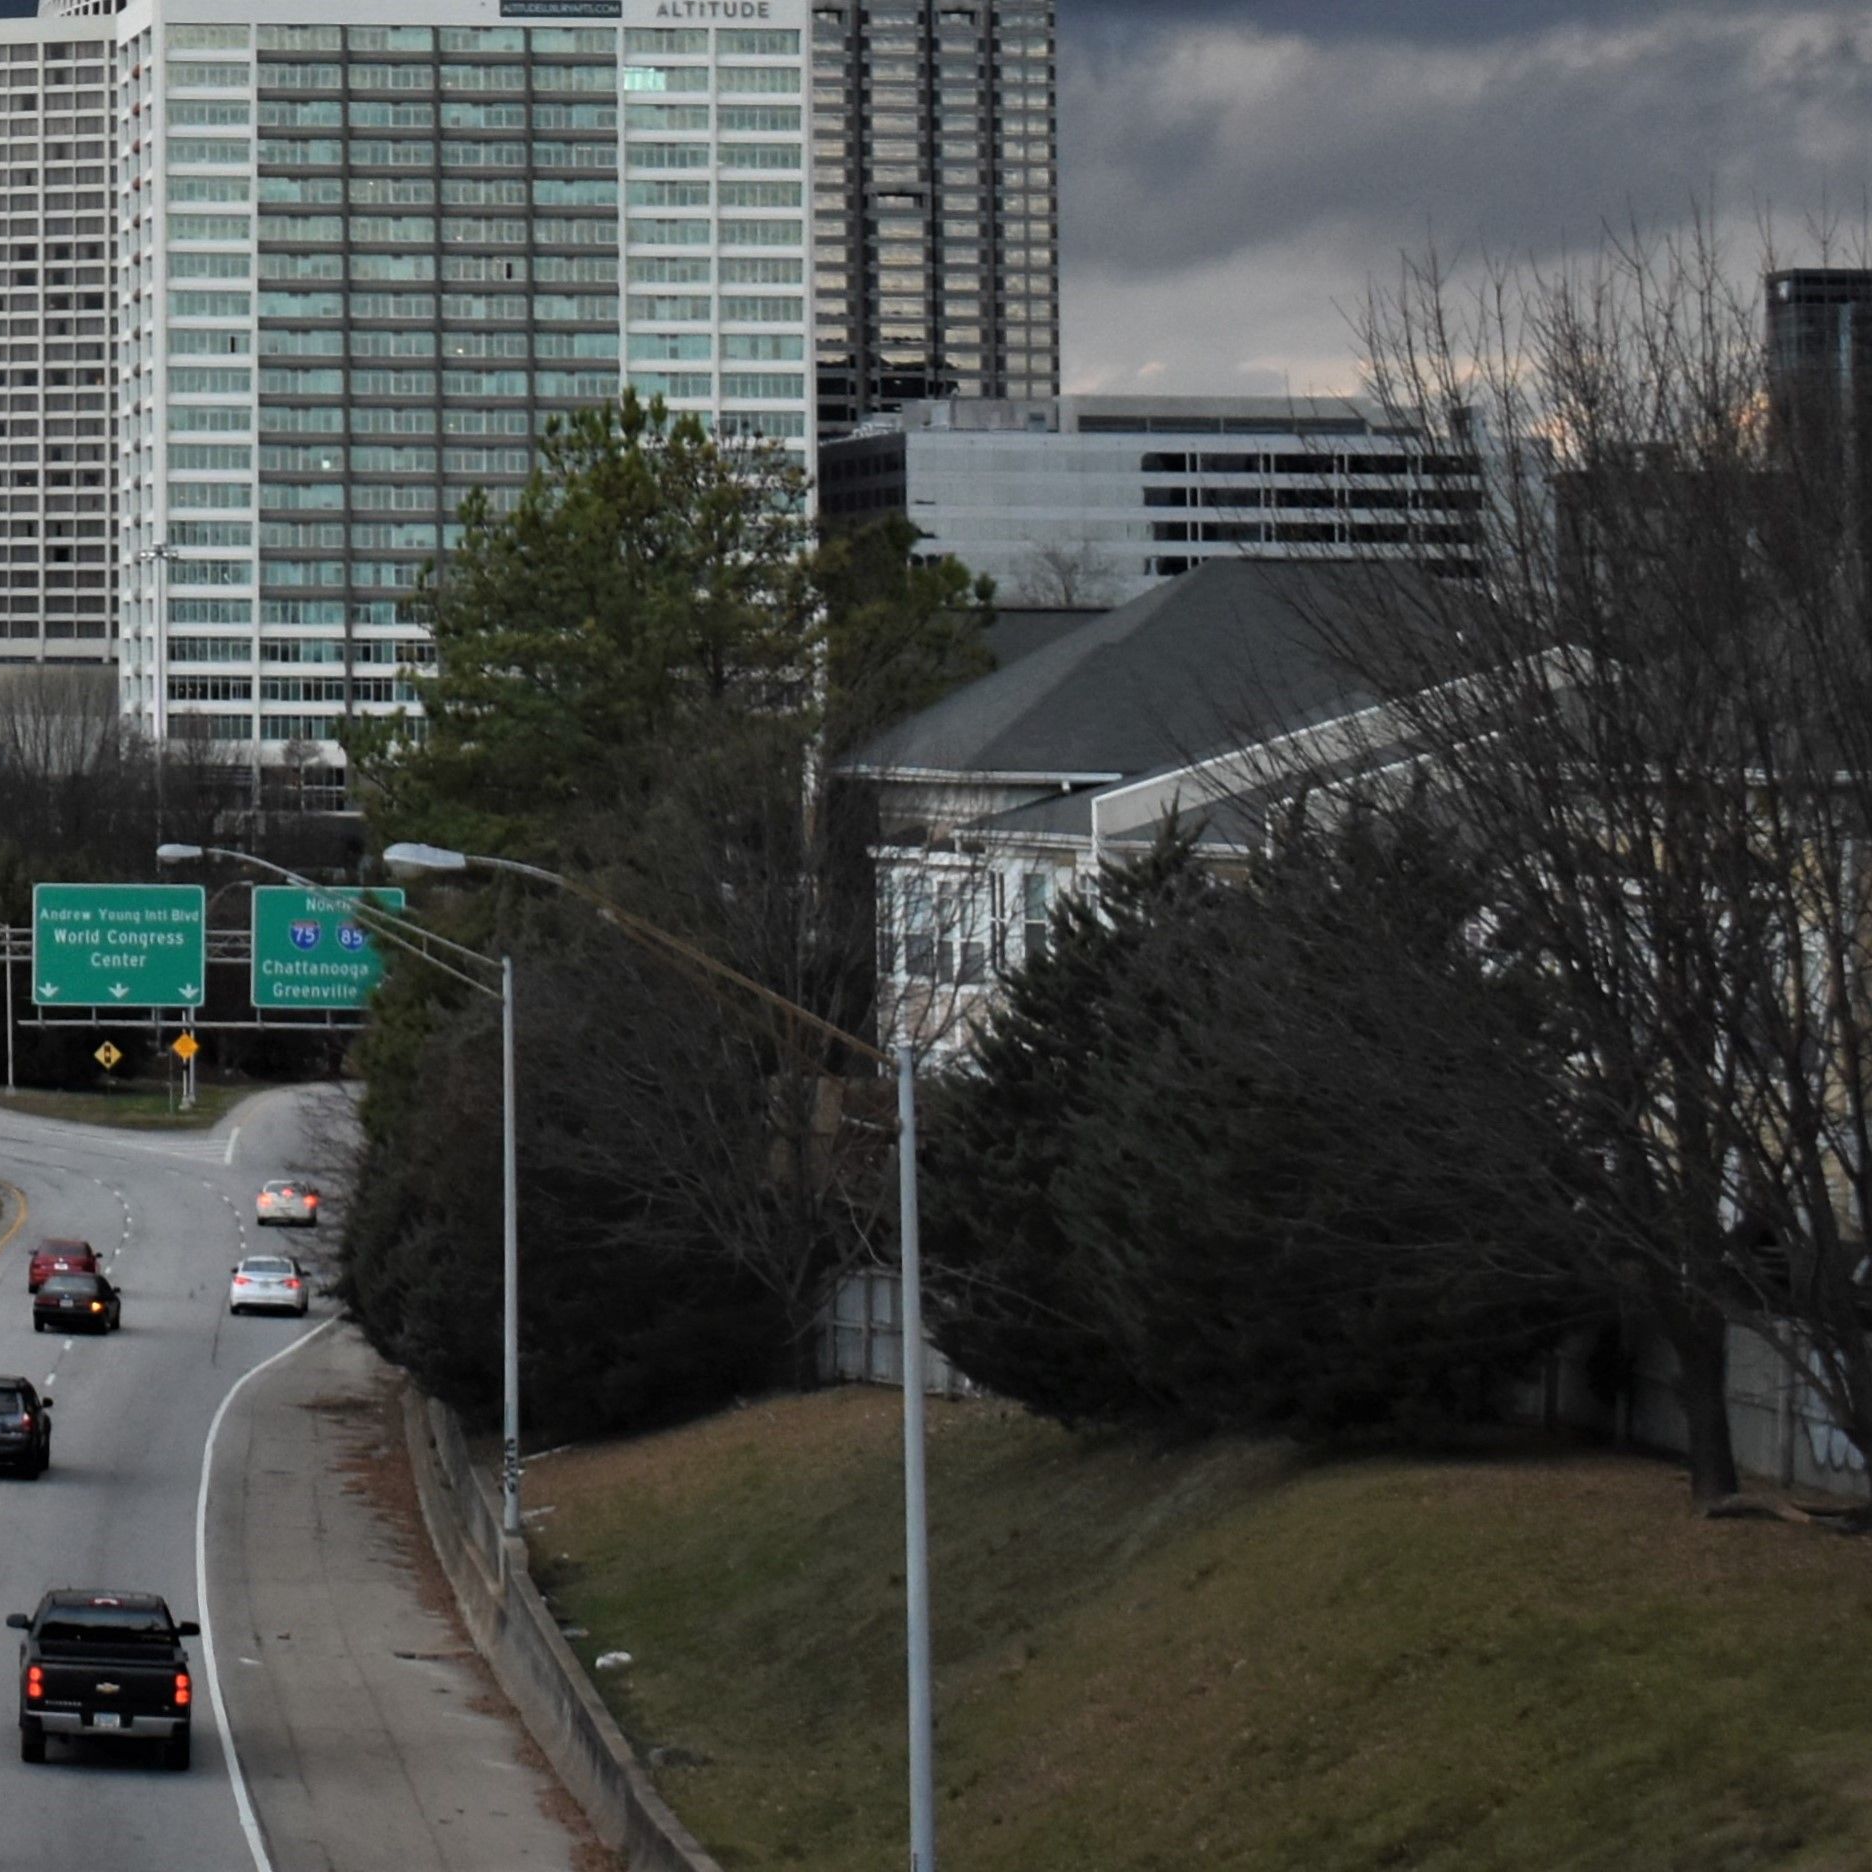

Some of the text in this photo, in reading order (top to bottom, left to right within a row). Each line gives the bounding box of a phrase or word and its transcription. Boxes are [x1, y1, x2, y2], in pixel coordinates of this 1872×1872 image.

[40, 908, 91, 920] Andrew
[99, 909, 140, 923] Young
[172, 910, 199, 922] Blvd
[54, 929, 184, 947] World Congress
[294, 928, 315, 943] 75
[341, 930, 362, 945] 85
[91, 953, 146, 967] Center
[263, 960, 369, 978] Chattanooga
[273, 982, 357, 998] Greenville
